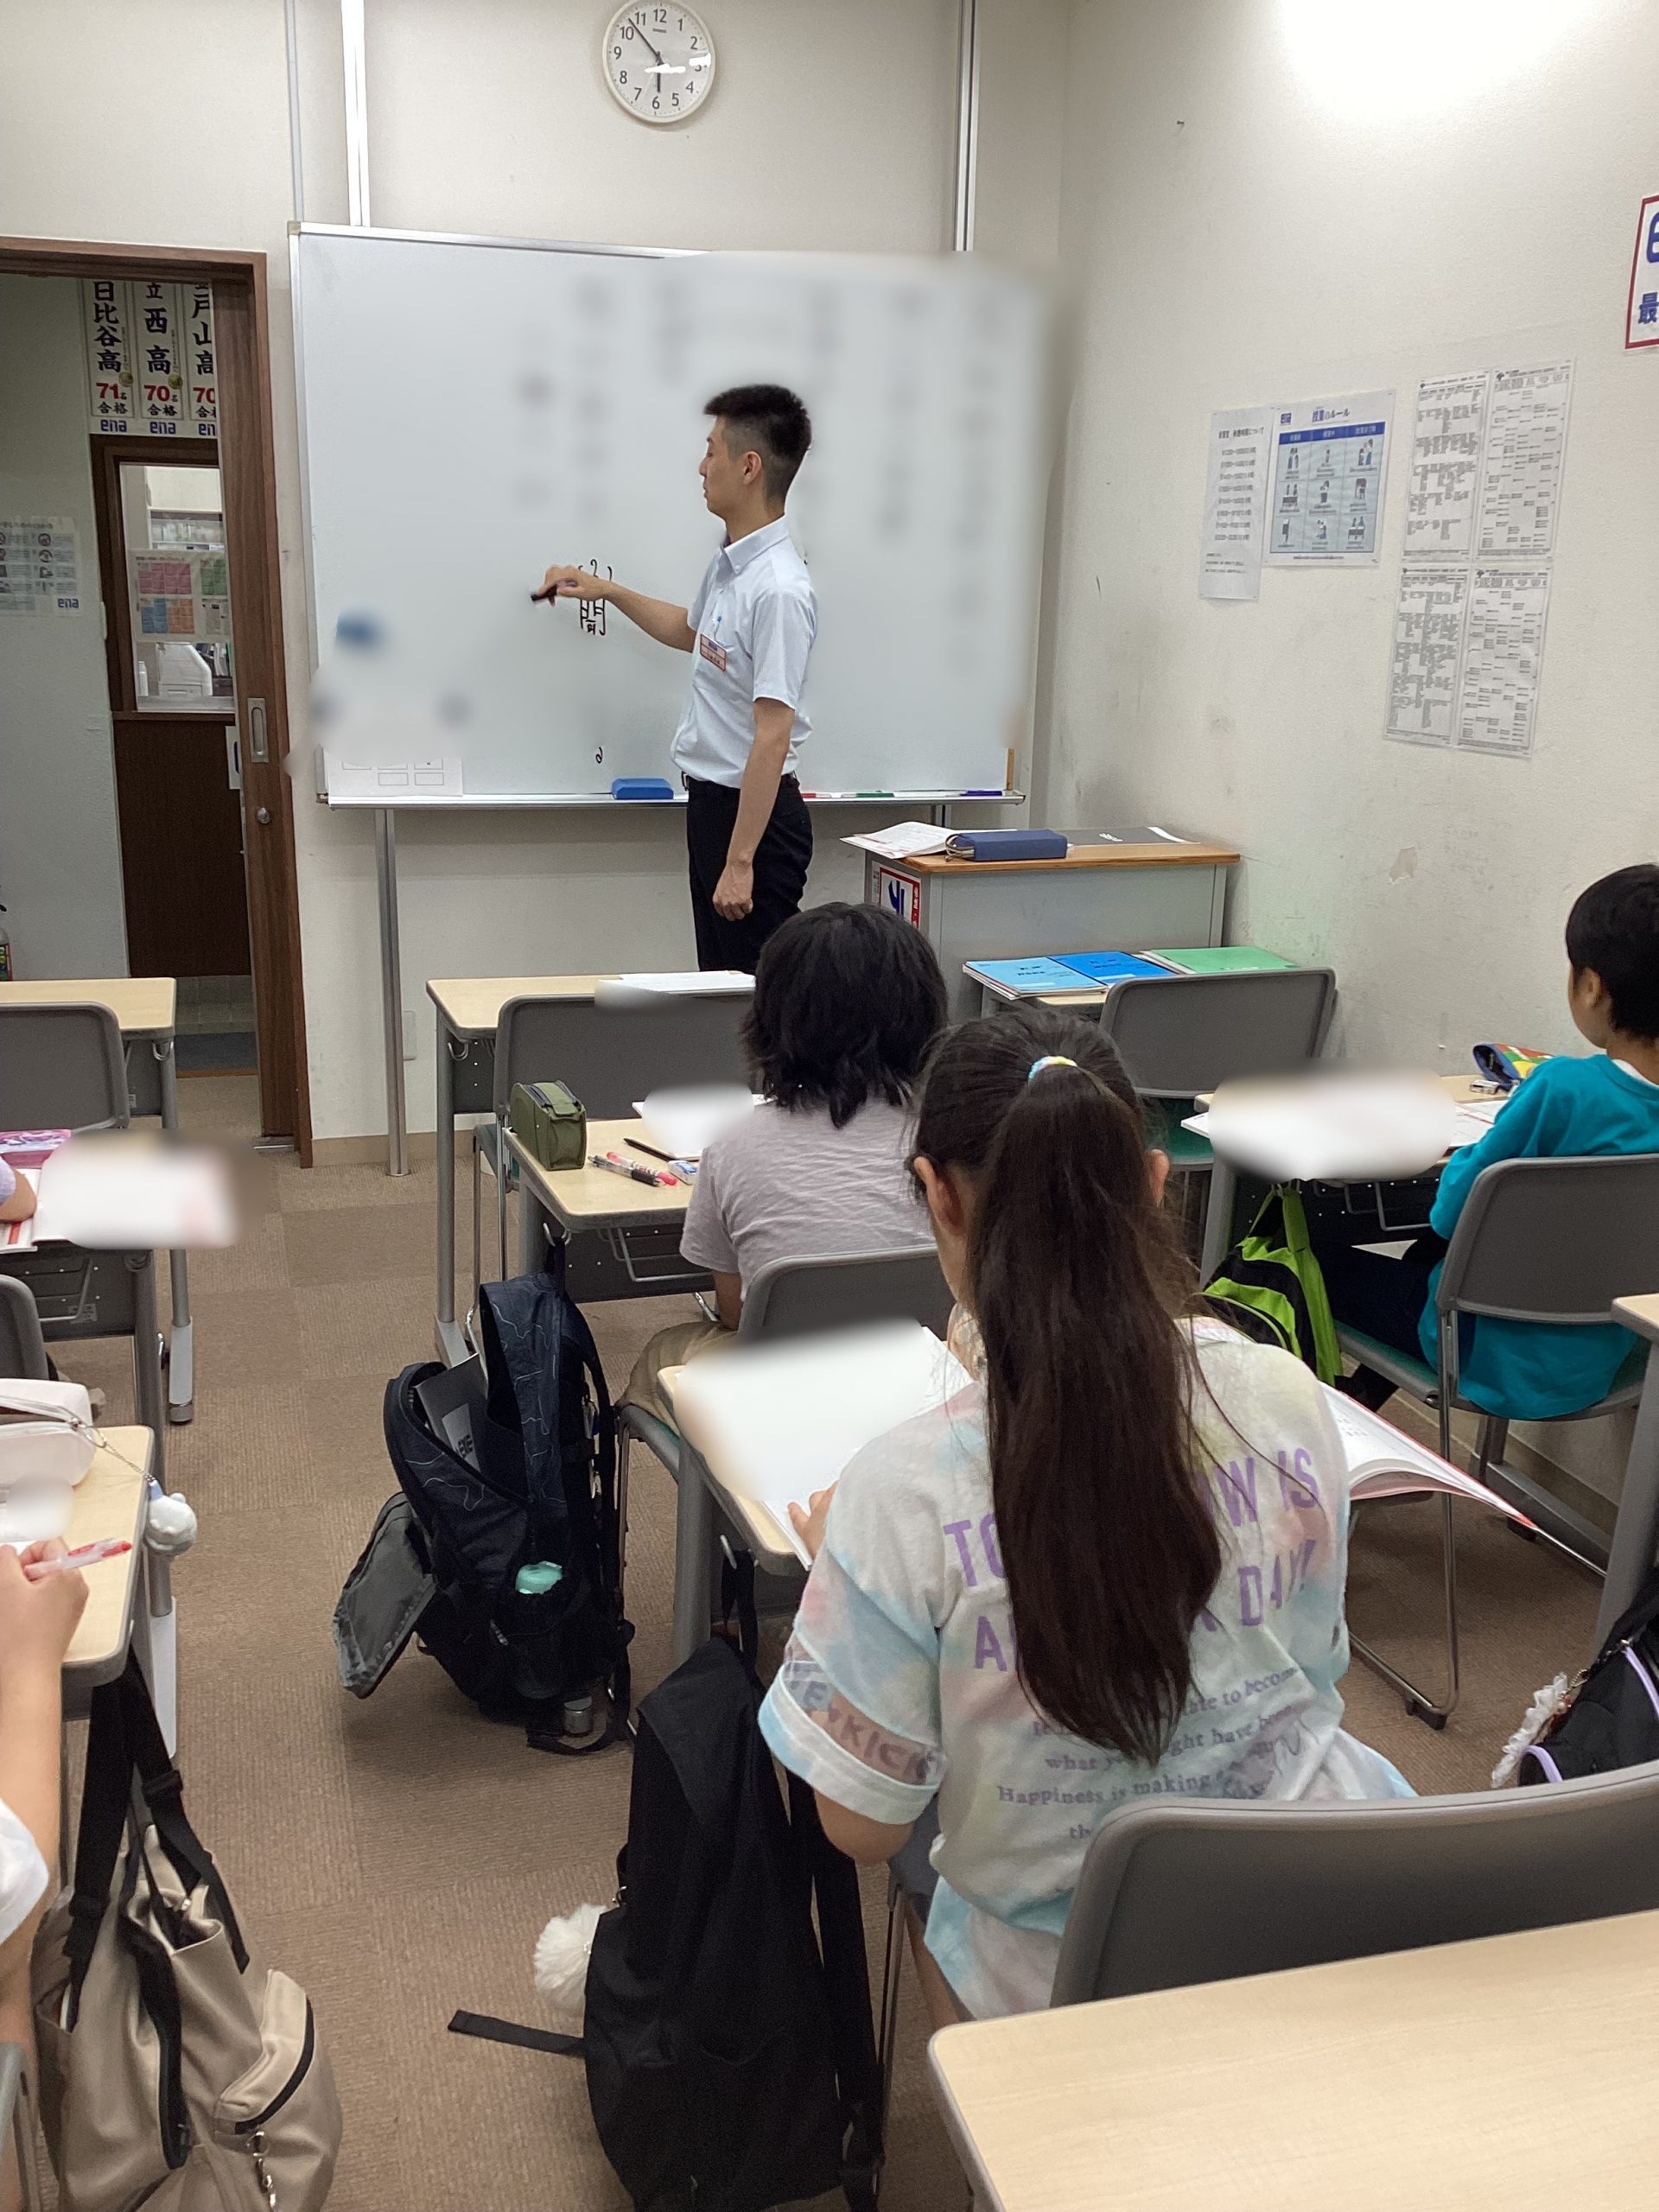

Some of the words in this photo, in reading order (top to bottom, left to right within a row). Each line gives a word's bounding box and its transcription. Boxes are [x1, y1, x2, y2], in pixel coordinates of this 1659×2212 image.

[635, 11, 646, 26] 11
[653, 9, 667, 22] 12
[677, 18, 683, 31] 1
[620, 26, 634, 41] 10
[690, 35, 698, 50] 2
[613, 46, 622, 60] 9
[620, 71, 627, 84] 8
[686, 80, 694, 93] 4
[634, 87, 642, 101] 7
[672, 92, 680, 106] 5
[652, 96, 660, 110] 6
[93, 282, 122, 373] 日比谷高
[143, 282, 171, 374] 立西高
[192, 284, 213, 375] 戸山高
[98, 402, 129, 415] 合格
[147, 404, 178, 416] 合格
[100, 419, 127, 433] ena
[149, 421, 175, 435] ena
[58, 598, 79, 608] ena
[1277, 1447, 1319, 1510] IS
[1223, 1690, 1241, 1706] to
[1045, 1753, 1089, 1770] what
[996, 1784, 1106, 1806] Happiness
[1131, 1773, 1211, 1796] making
